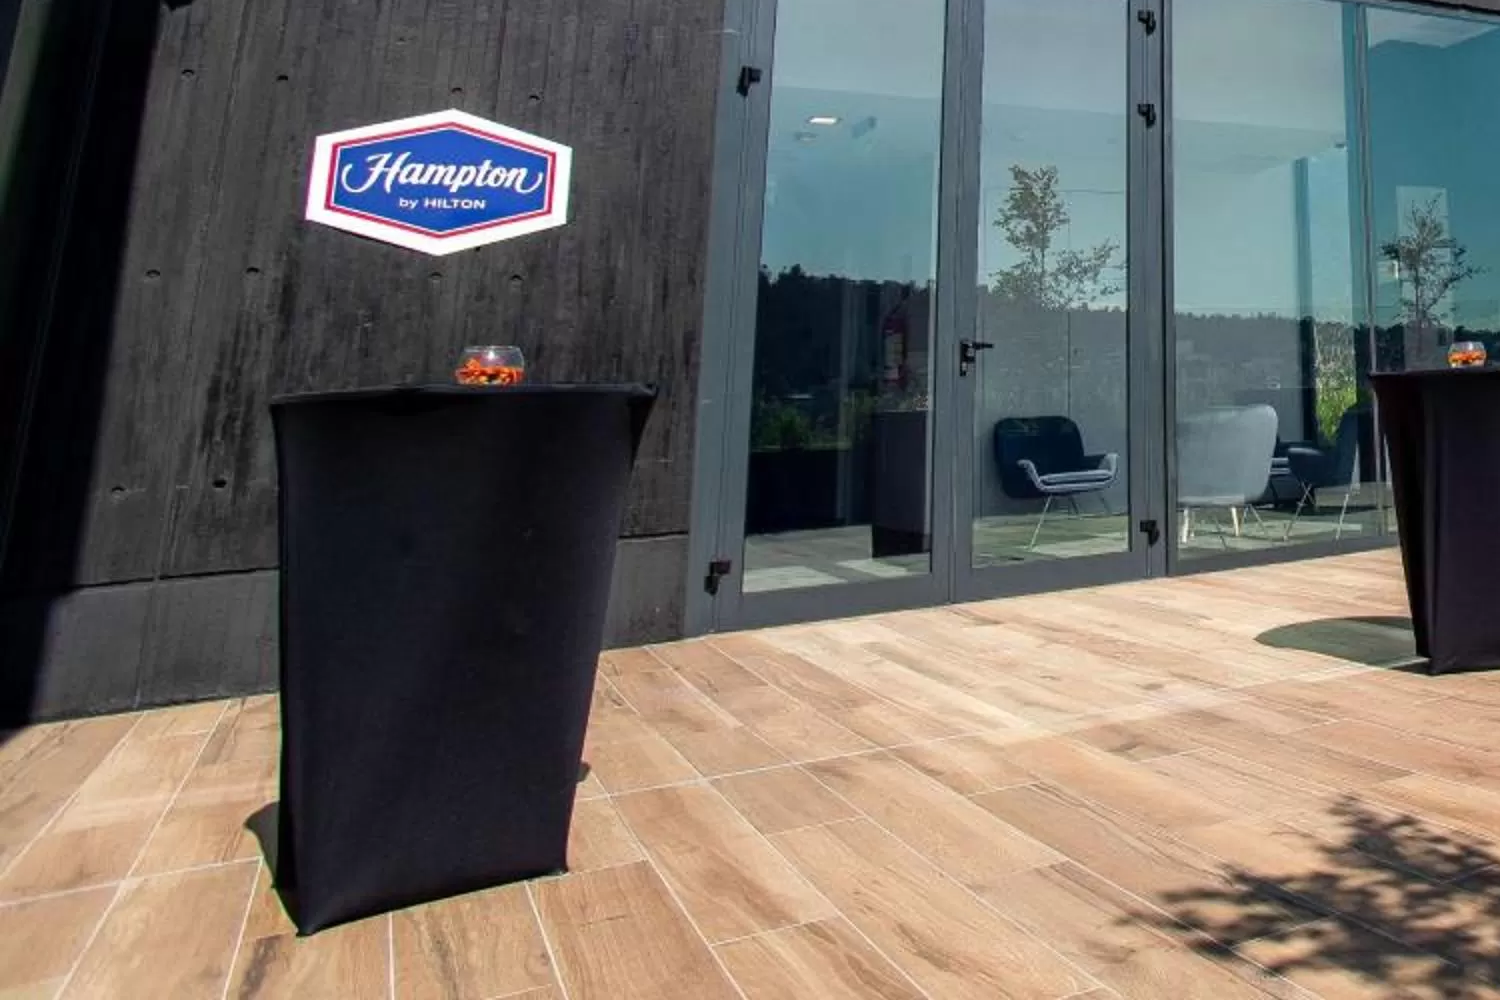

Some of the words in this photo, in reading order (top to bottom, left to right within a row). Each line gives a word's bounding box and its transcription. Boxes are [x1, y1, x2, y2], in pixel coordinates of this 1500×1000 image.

[341, 151, 543, 193] Hampton
[399, 197, 418, 210] by
[424, 198, 486, 209] HILTON
